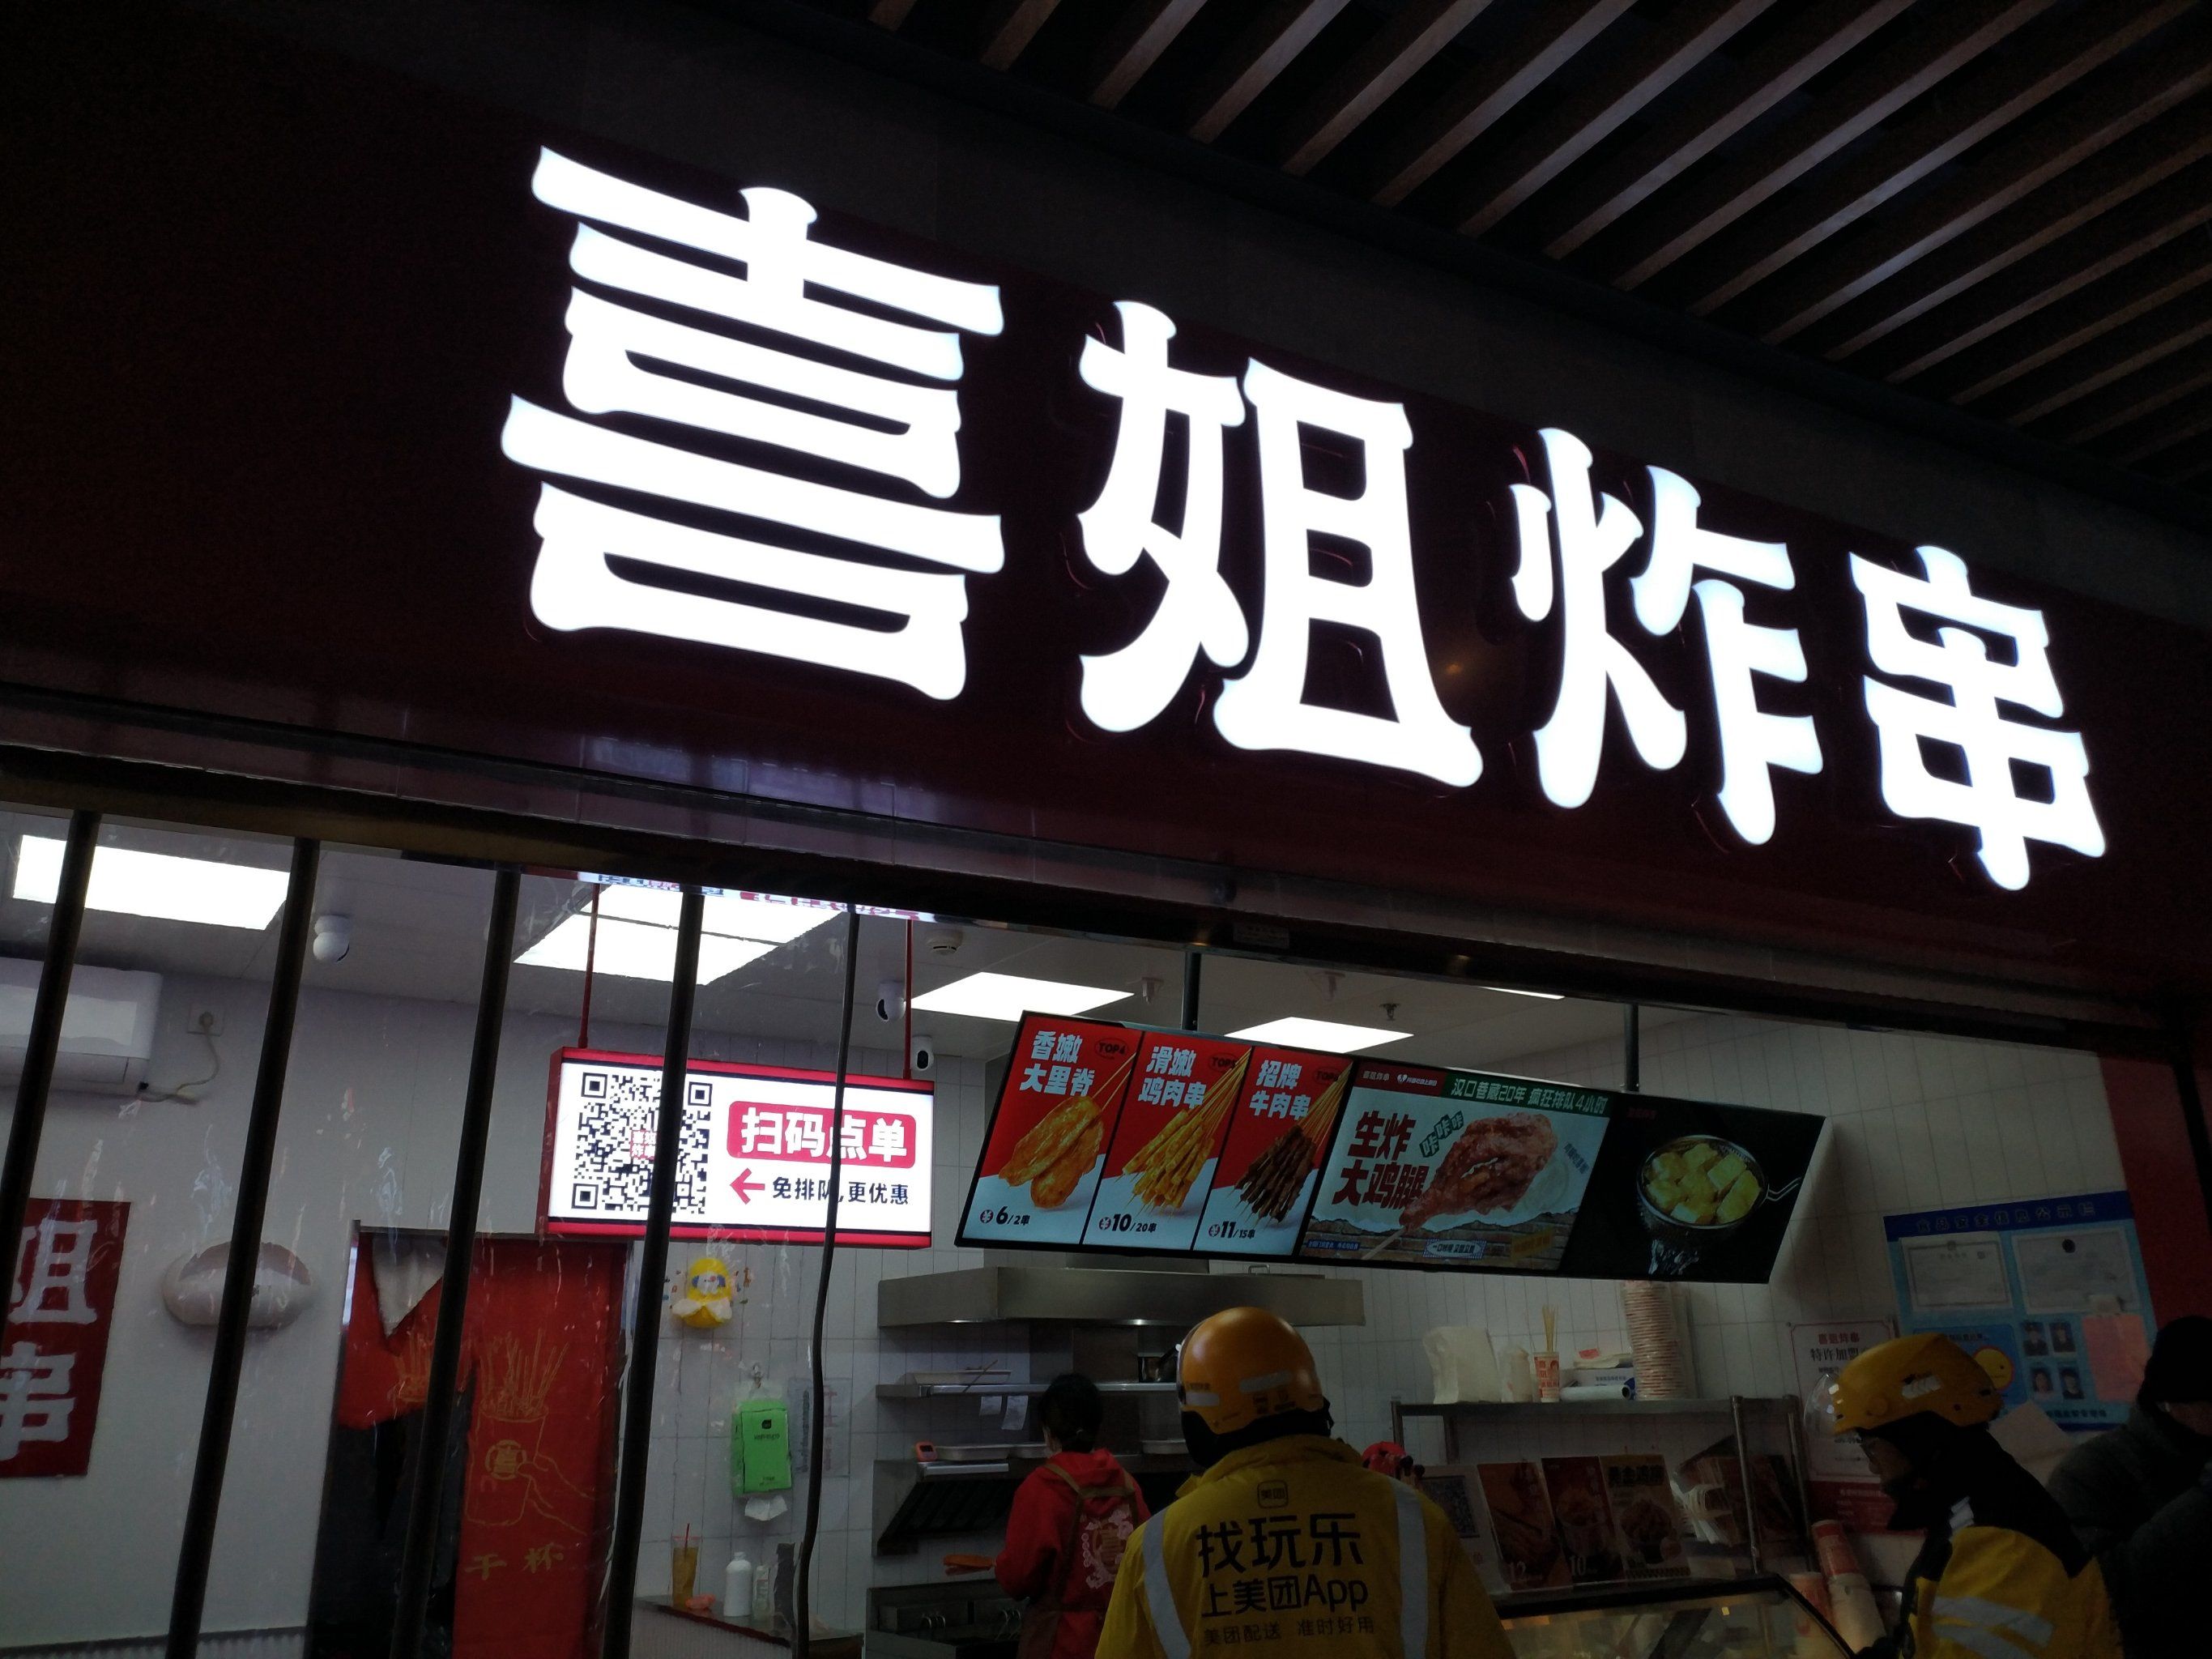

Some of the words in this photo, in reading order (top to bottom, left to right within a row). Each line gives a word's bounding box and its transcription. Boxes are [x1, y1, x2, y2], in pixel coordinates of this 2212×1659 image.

[501, 146, 2105, 892] 喜姐炸串
[1031, 1030, 1082, 1064] 香嫩
[1098, 1043, 1126, 1056] TOP4
[1146, 1046, 1197, 1078] 滑嫩
[1020, 1063, 1095, 1097] 大里脊
[1256, 1060, 1302, 1090] 招牌
[1139, 1077, 1207, 1109] 鸡肉串
[1249, 1090, 1311, 1120] 牛肉串
[741, 1107, 908, 1162] 扫码点单
[1348, 1111, 1416, 1160] 生炸
[1332, 1159, 1429, 1209] 大鸡腿
[1809, 1347, 1866, 1362] 特许加盟
[1196, 1513, 1363, 1577] 找玩乐
[1204, 1621, 1282, 1648] 美团配送
[1298, 1616, 1375, 1636] 准时好用
